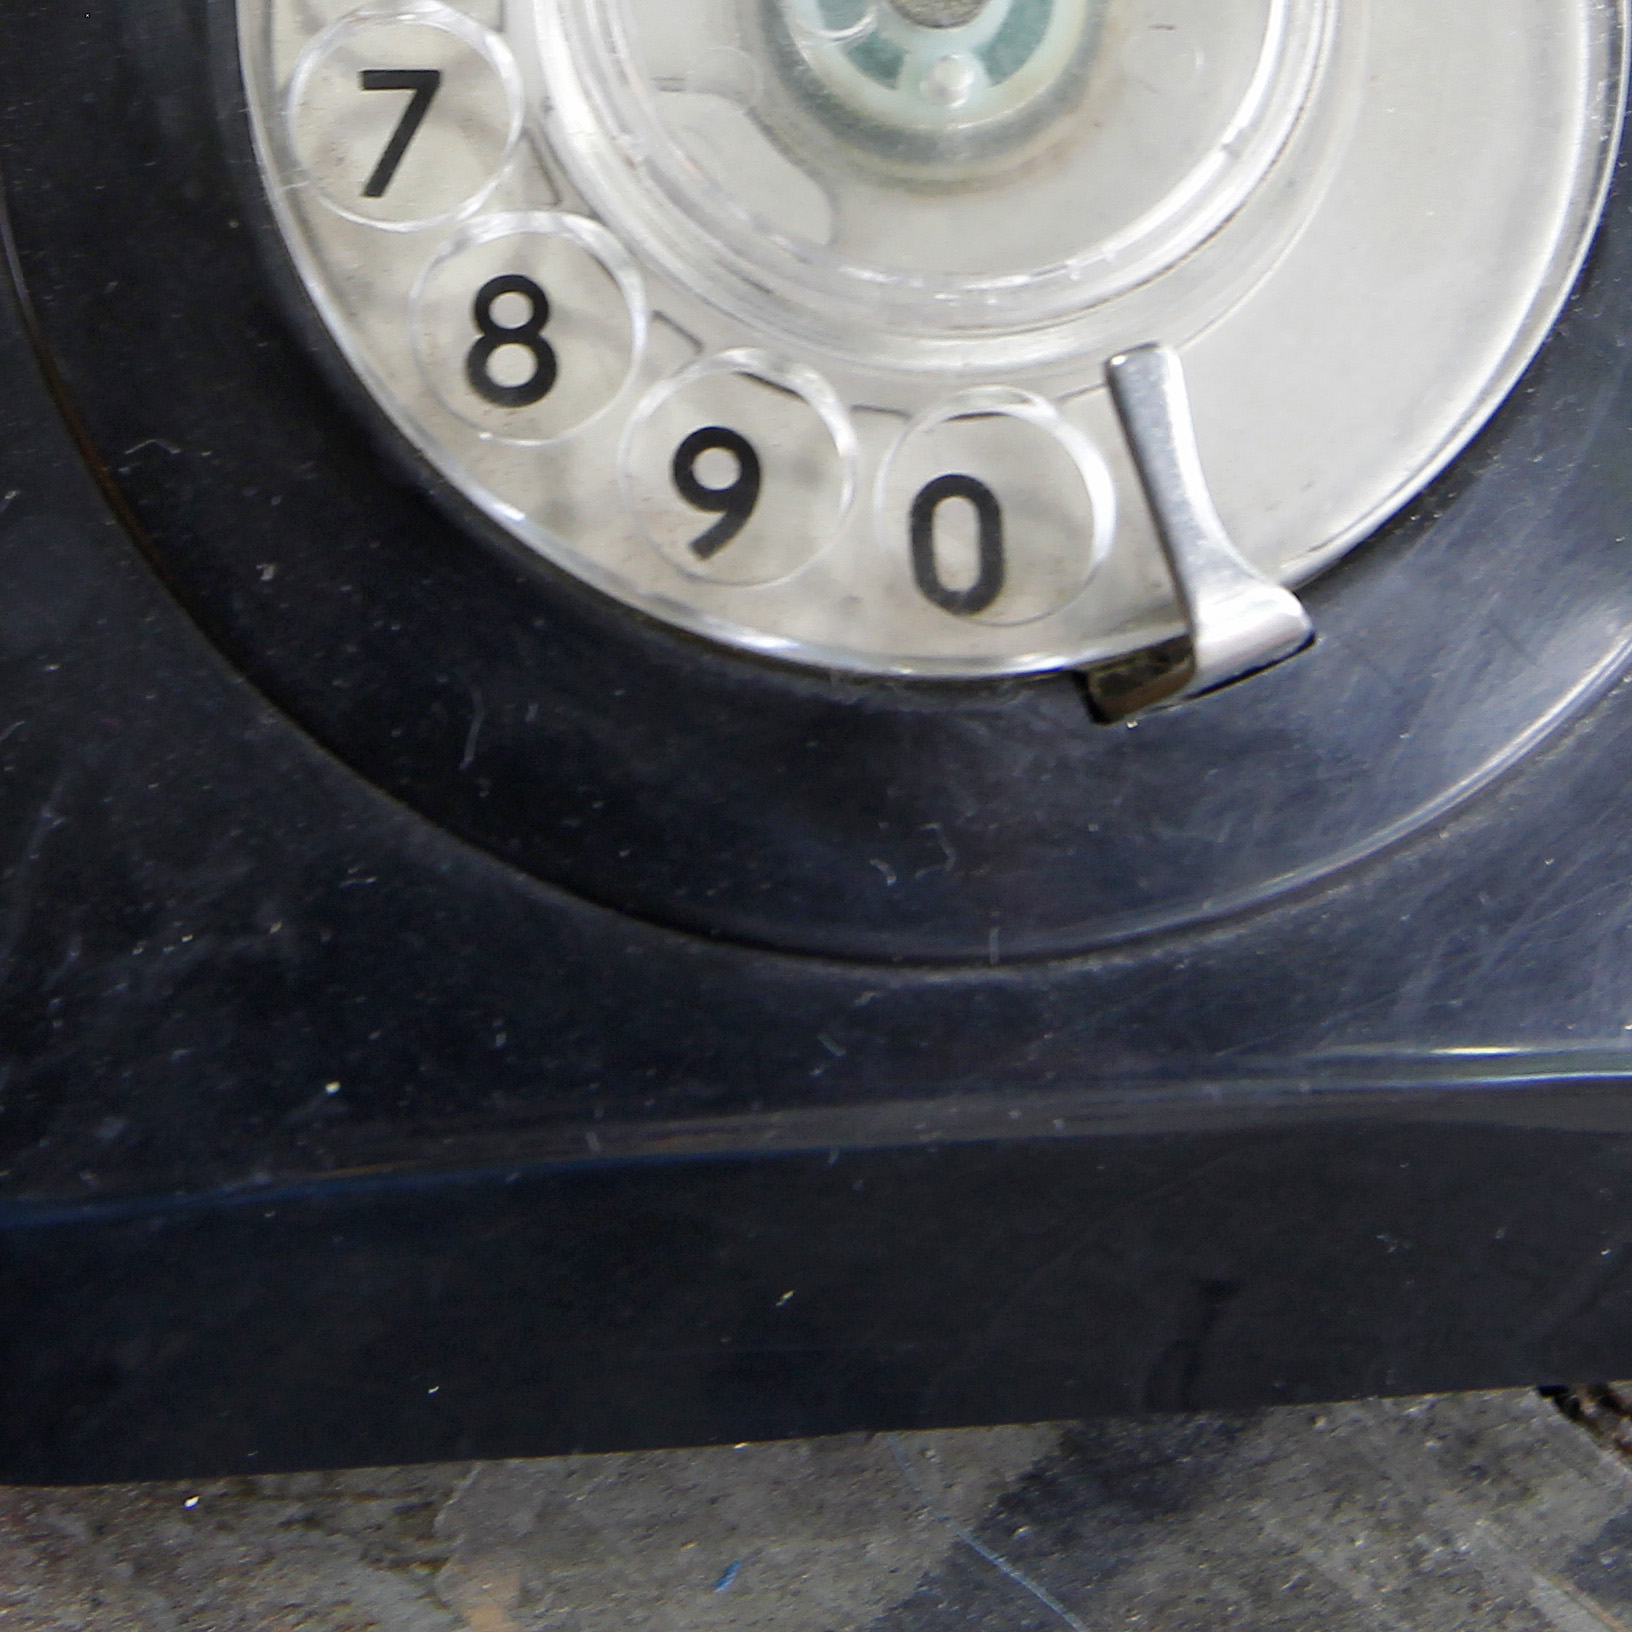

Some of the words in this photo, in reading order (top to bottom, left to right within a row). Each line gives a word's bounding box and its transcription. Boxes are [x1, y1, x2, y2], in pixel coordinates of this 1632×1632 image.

[358, 68, 442, 199] 7
[465, 273, 559, 409] 8
[671, 425, 763, 560] 9
